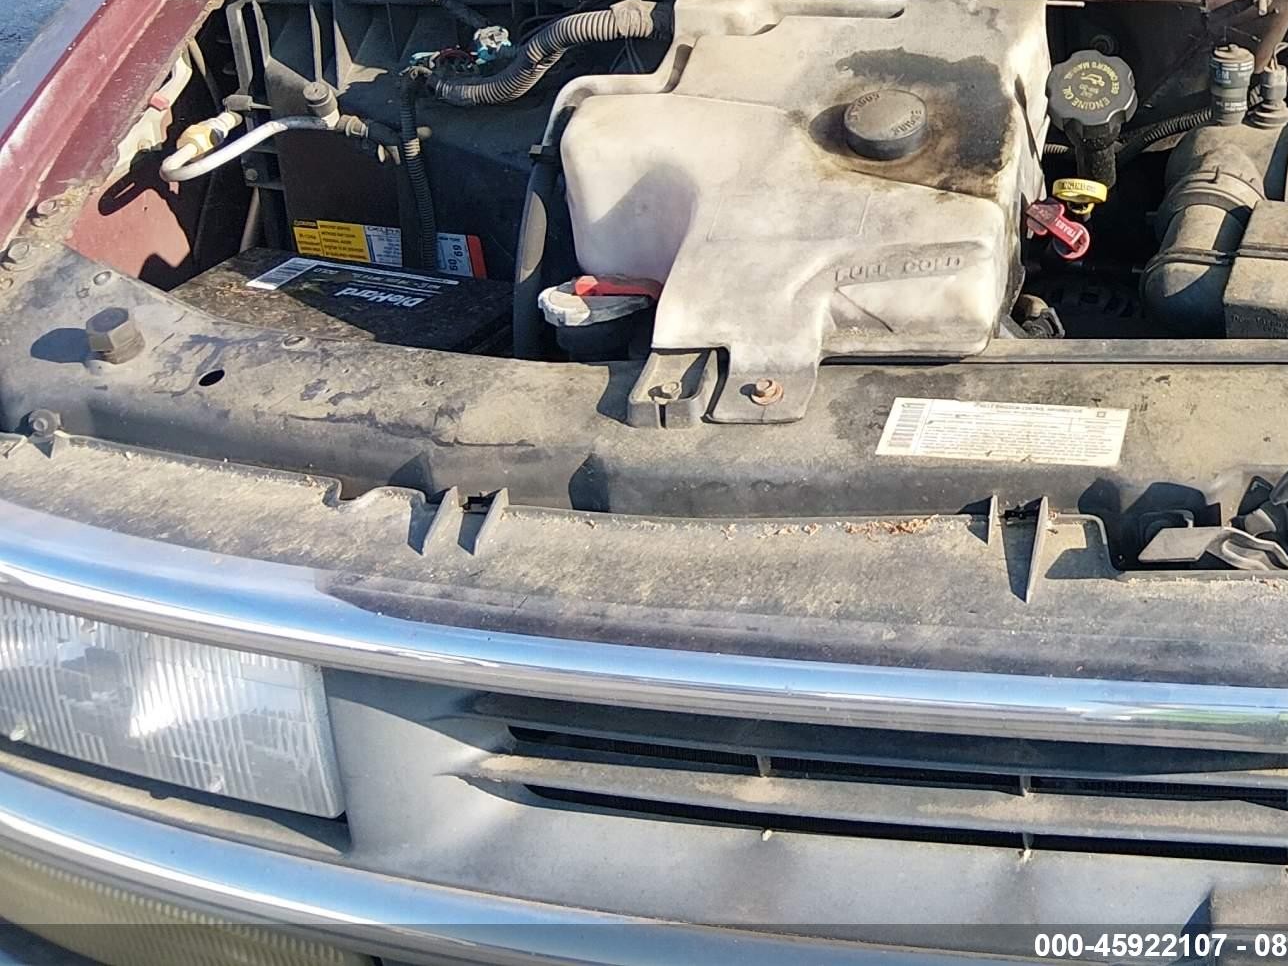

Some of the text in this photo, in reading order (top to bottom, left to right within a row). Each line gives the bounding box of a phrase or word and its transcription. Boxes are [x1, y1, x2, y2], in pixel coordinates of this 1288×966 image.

[1062, 85, 1110, 111] ENGINE OIL
[334, 287, 426, 308] DieHard
